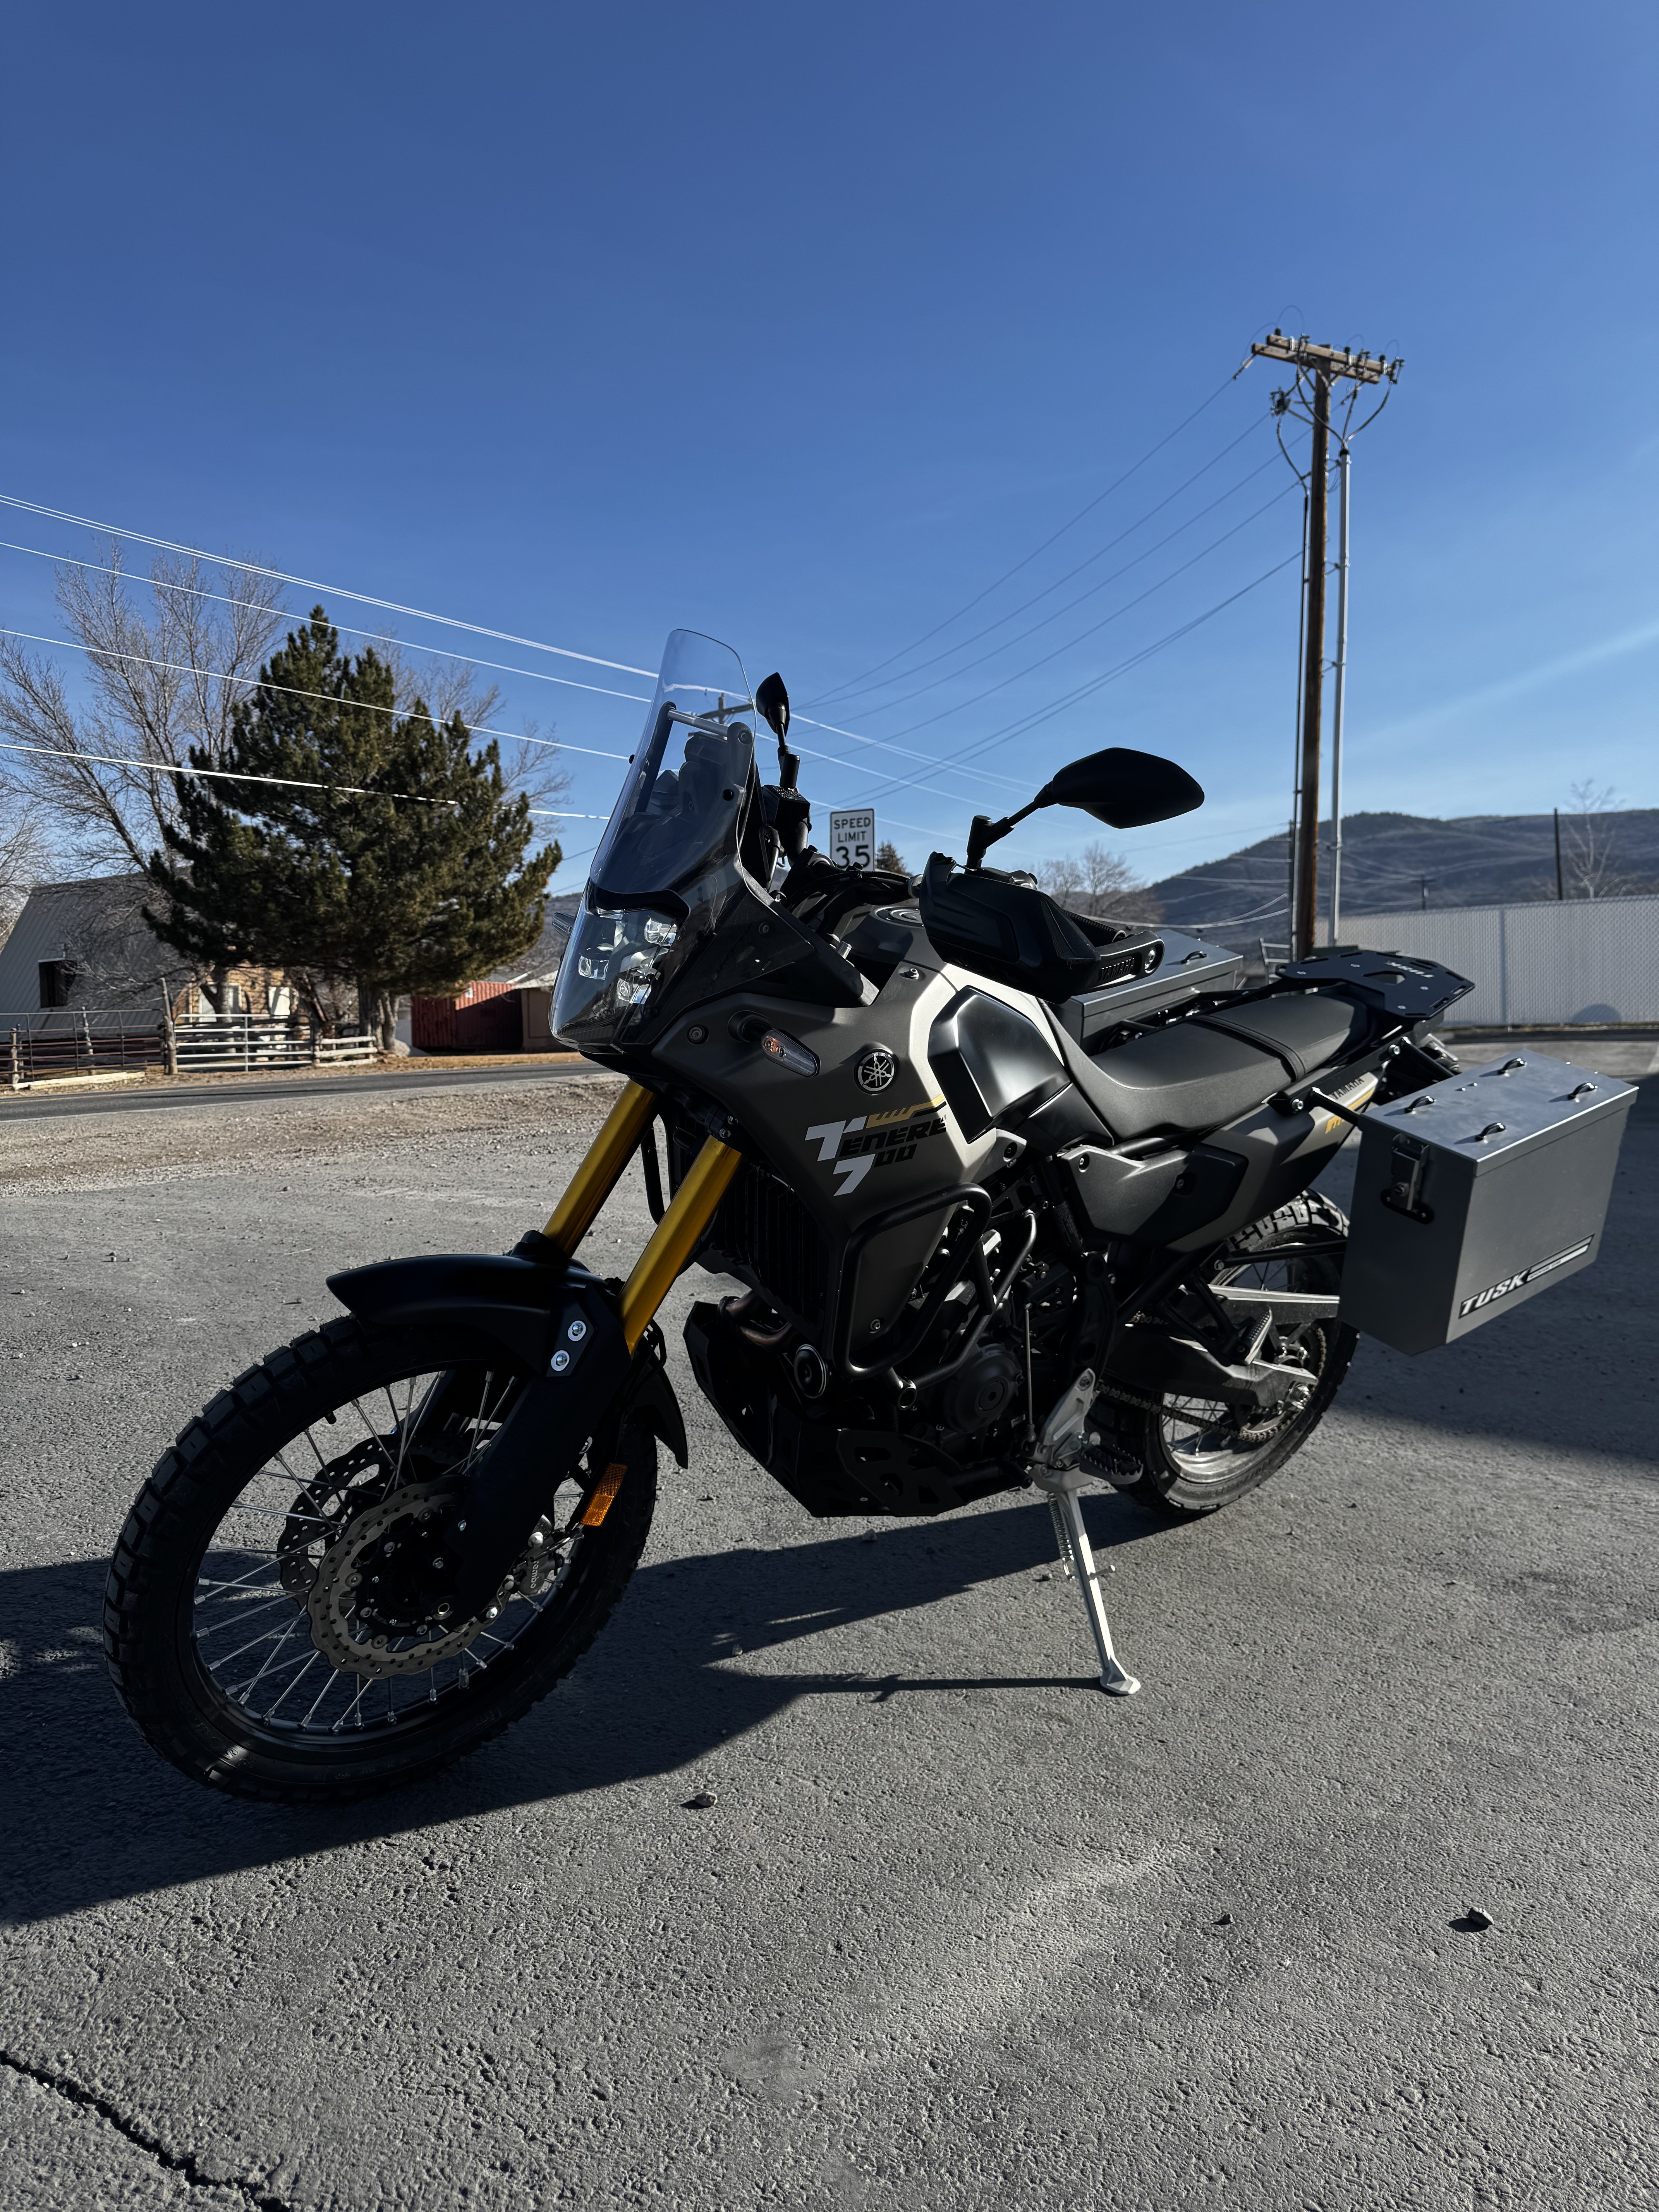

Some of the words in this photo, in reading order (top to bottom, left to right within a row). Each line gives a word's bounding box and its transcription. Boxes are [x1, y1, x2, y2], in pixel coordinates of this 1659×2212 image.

[834, 817, 871, 830] SPEED
[838, 831, 867, 843] LIMIT
[836, 845, 870, 868] 35
[1100, 958, 1135, 981] YAMAHA
[1461, 1269, 1529, 1316] TUSK
[530, 1560, 539, 1589] rembo
